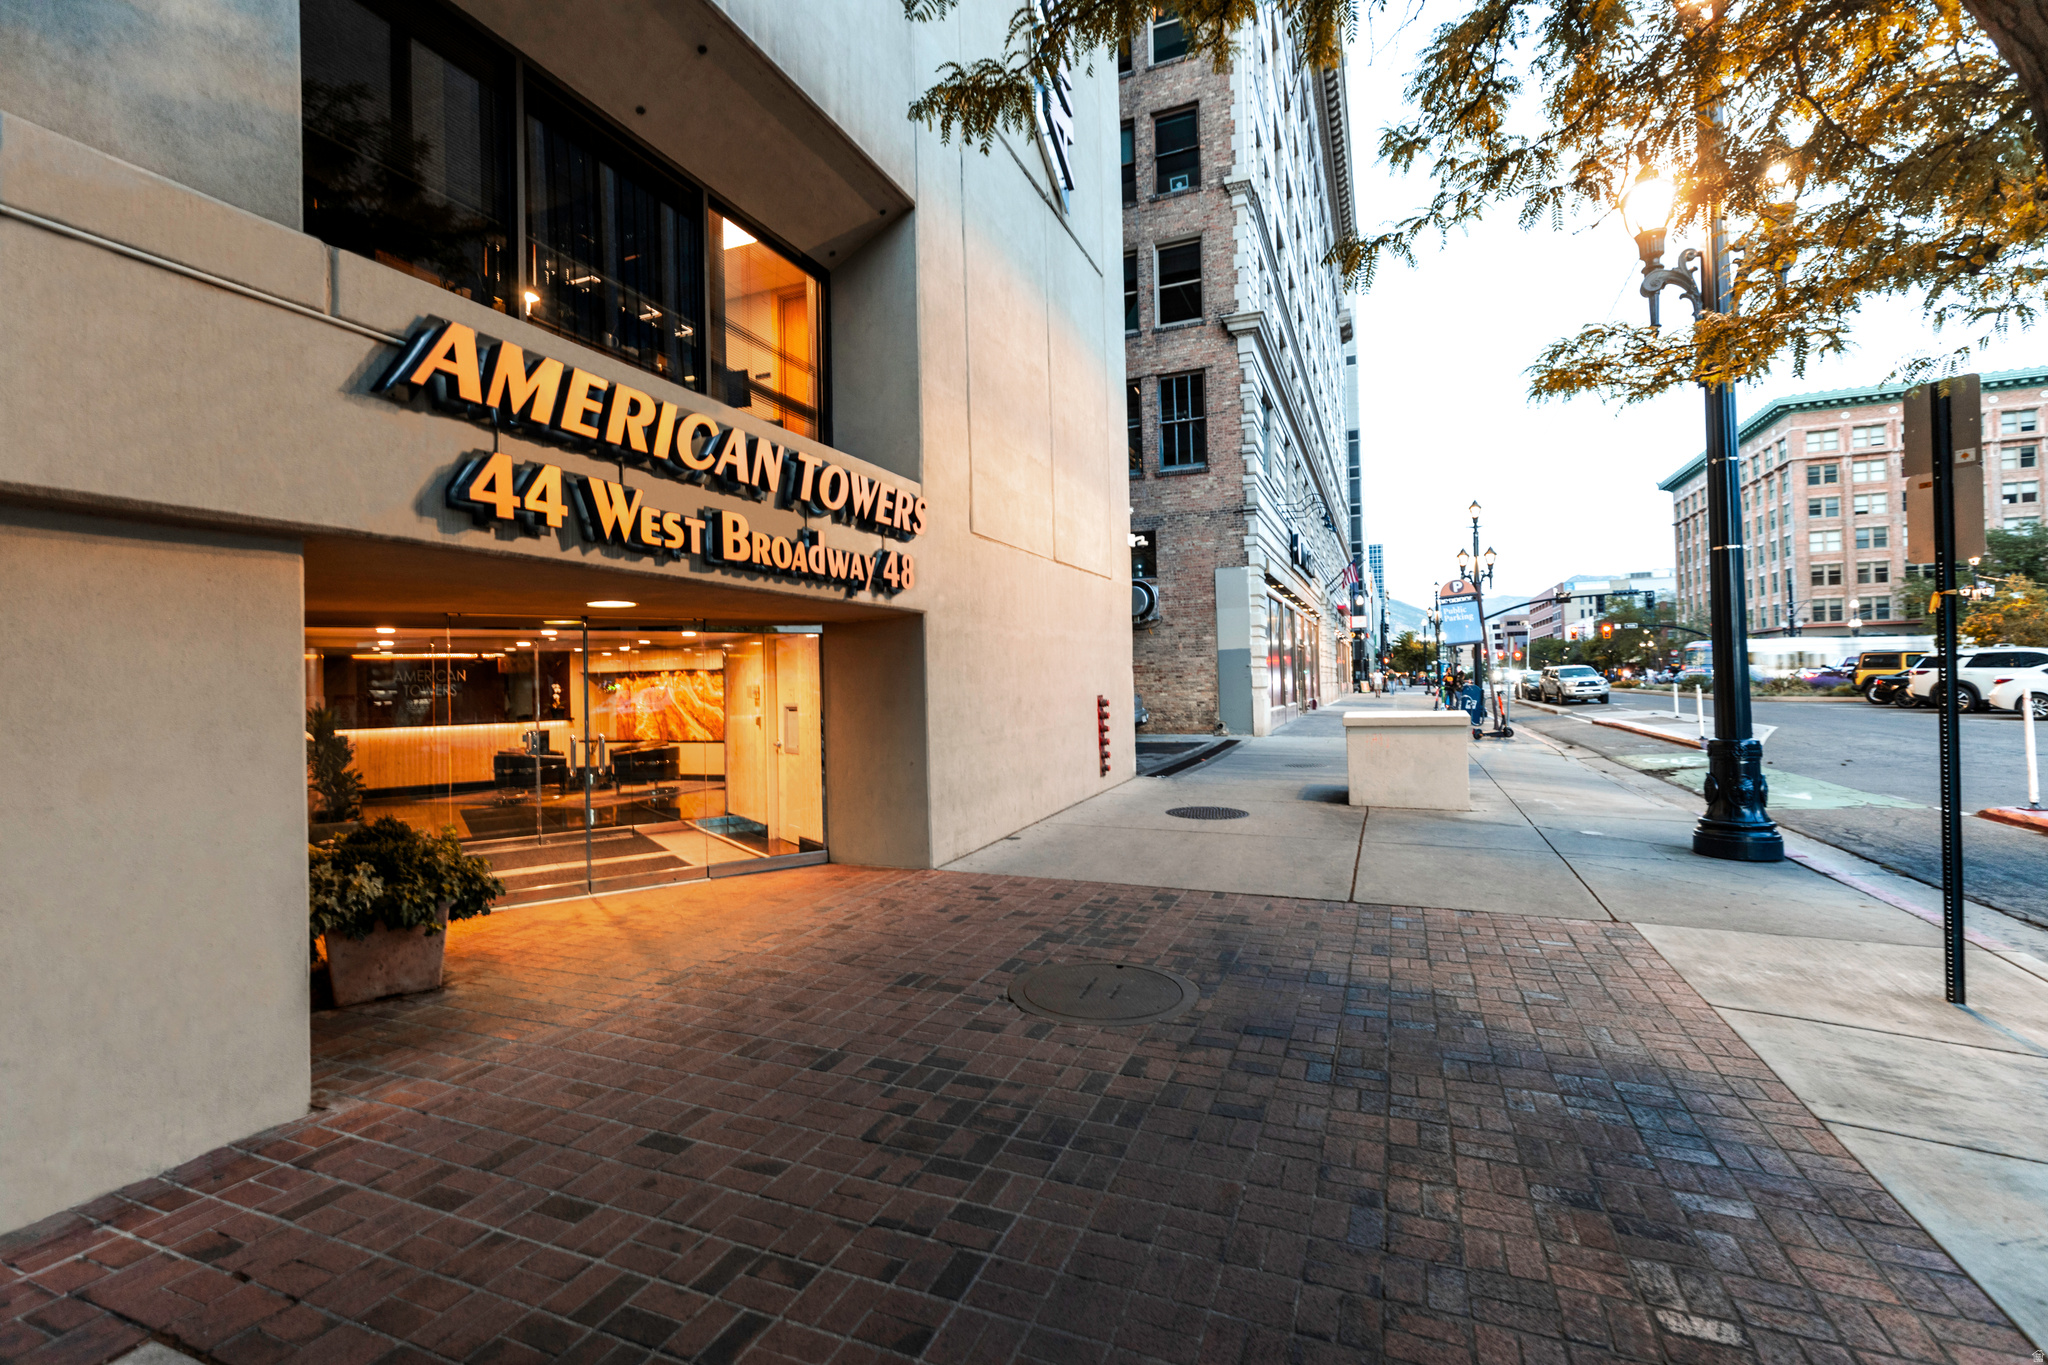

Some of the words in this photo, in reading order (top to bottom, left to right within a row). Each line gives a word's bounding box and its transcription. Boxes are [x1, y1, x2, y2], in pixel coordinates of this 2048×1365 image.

[411, 322, 784, 493] AMERICAN
[798, 451, 928, 535] TOWERS
[469, 452, 569, 528] 44
[588, 476, 706, 555] WEST
[883, 551, 916, 590] 48
[1442, 606, 1467, 615] Public
[1444, 613, 1474, 622] Parking
[394, 669, 467, 682] AMERCAN
